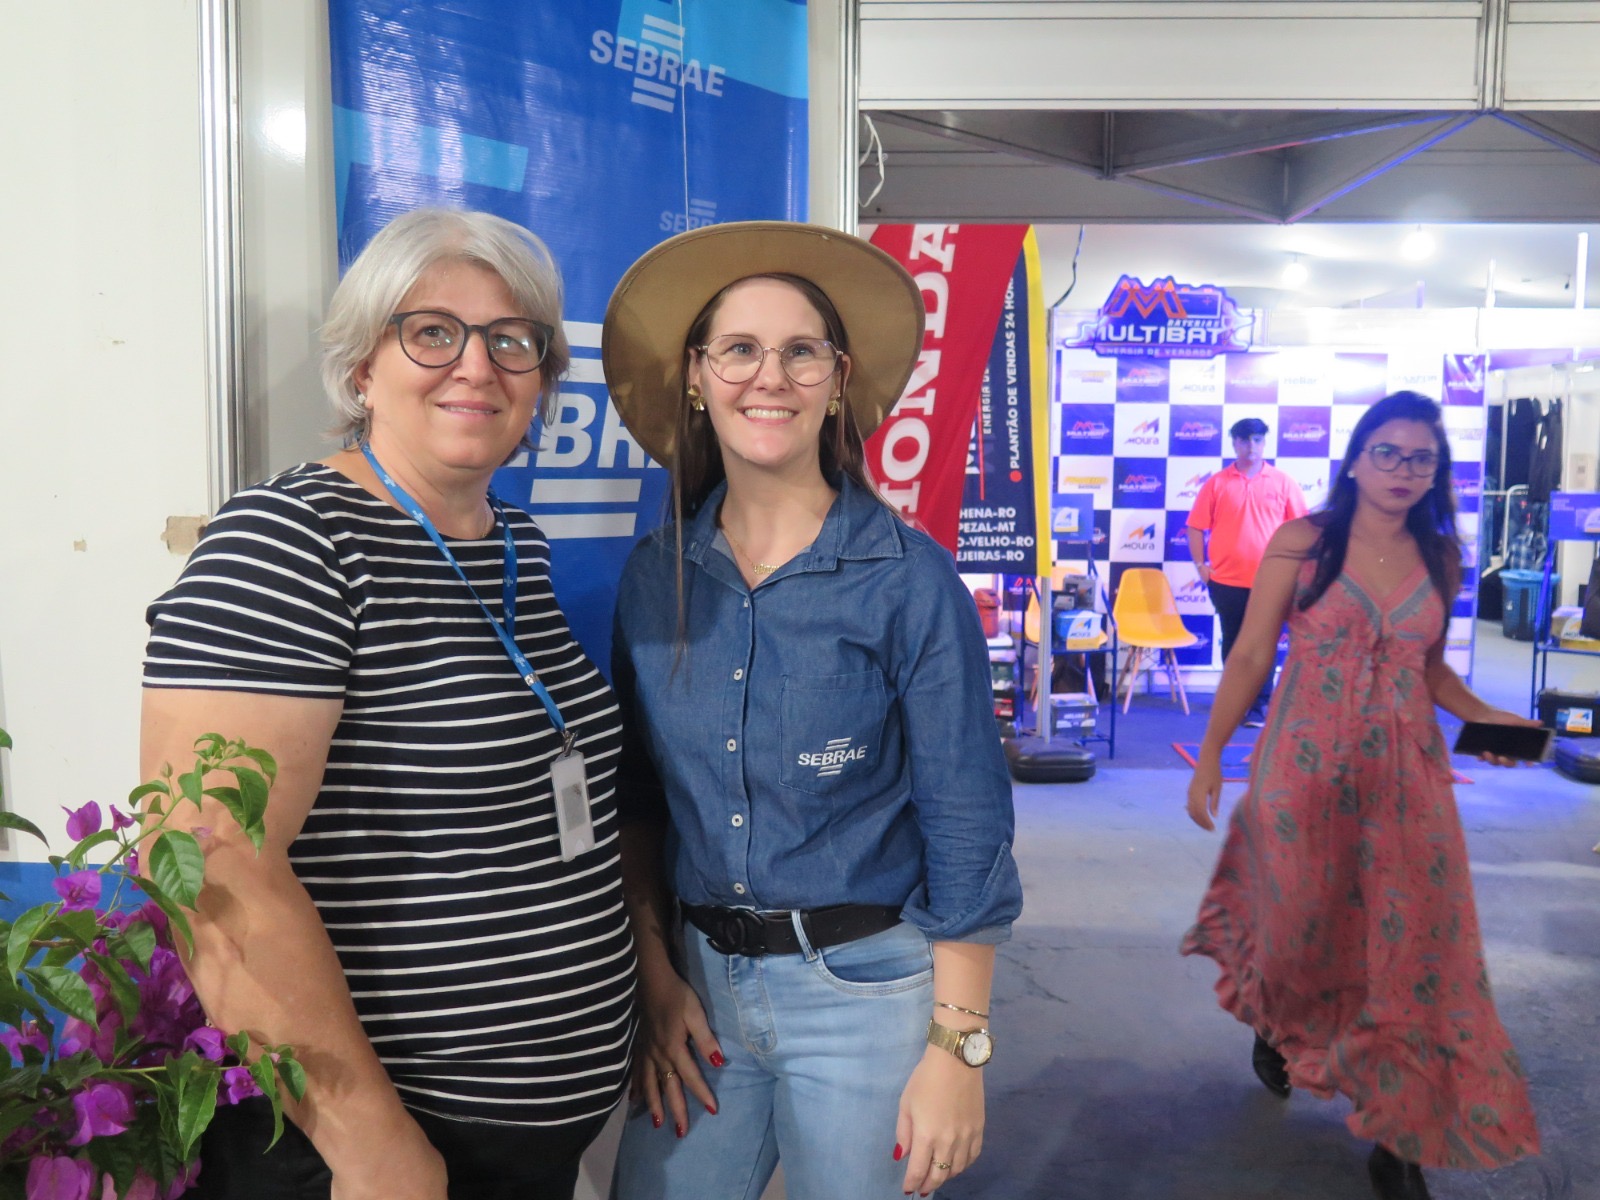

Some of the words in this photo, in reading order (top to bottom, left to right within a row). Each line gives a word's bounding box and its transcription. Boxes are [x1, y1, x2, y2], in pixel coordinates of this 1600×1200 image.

[589, 29, 726, 98] SEBRAE
[1004, 312, 1015, 329] 24
[1004, 331, 1018, 381] VENDAS
[1006, 385, 1018, 406] DE
[1005, 409, 1021, 470] PLANTÃO
[798, 745, 868, 766] SEBRAE
